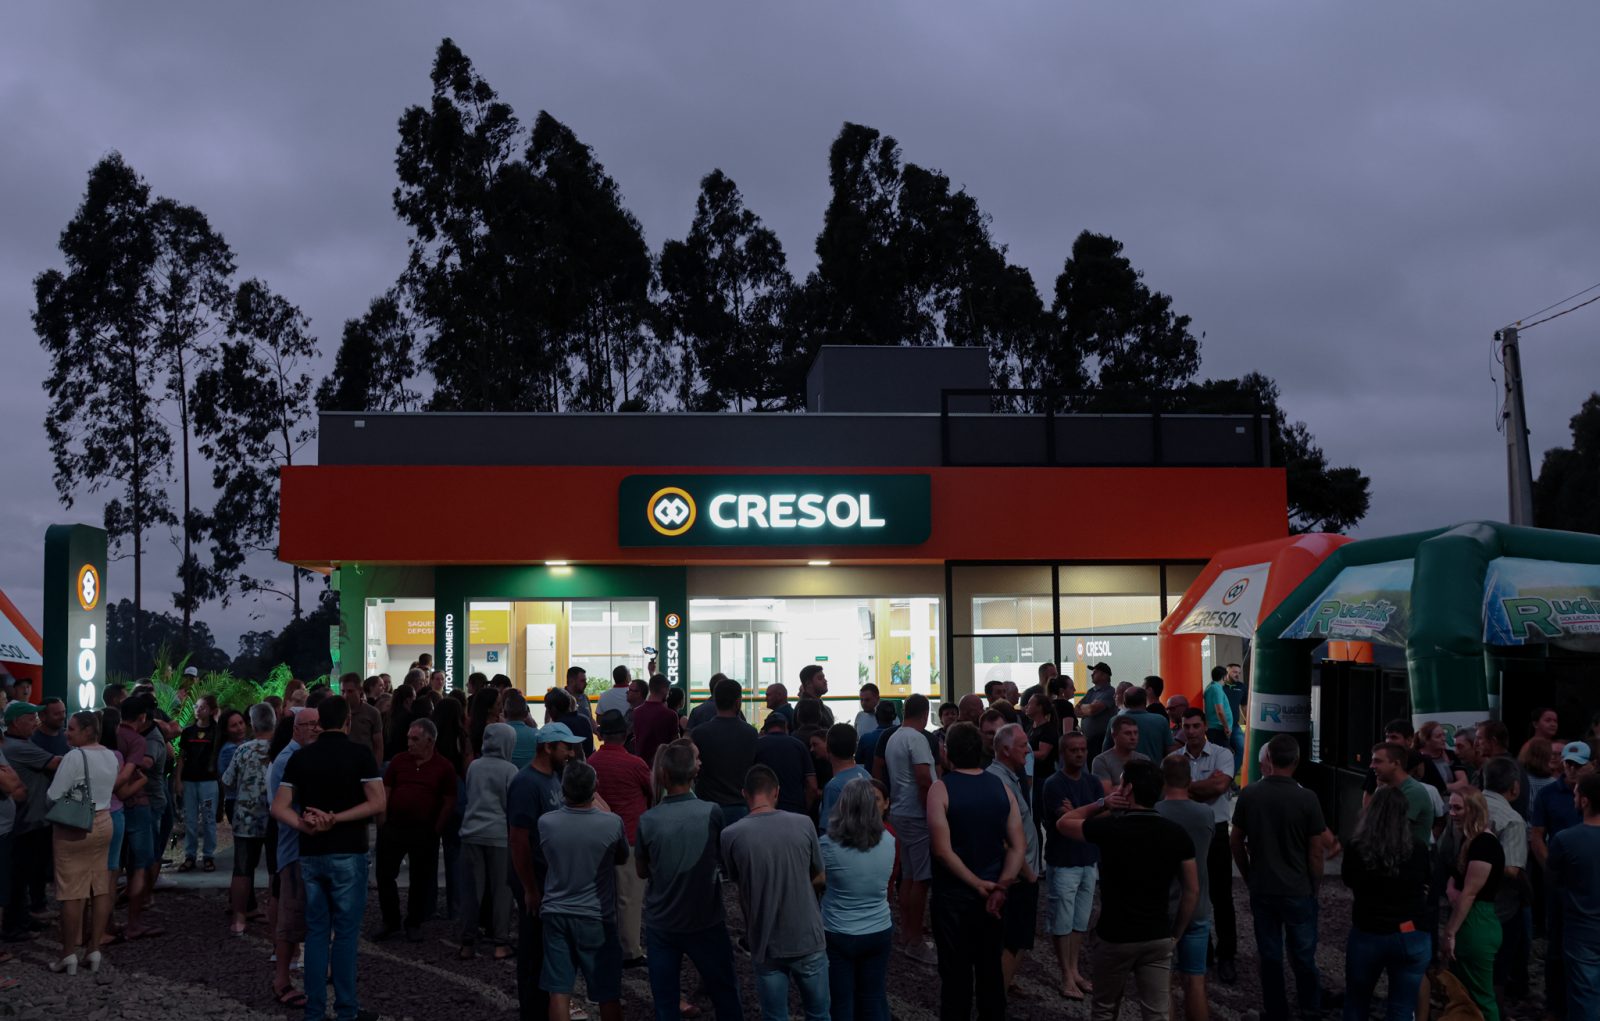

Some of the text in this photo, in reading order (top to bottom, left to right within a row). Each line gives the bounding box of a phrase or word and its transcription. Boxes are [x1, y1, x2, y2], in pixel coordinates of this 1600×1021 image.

[709, 493, 886, 529] CRESOL
[1306, 600, 1396, 634] Rudnik
[78, 623, 96, 710] SOL
[445, 613, 454, 694] UTOATENDIMENTO
[667, 631, 679, 685] CRESOL
[1086, 641, 1112, 657] CRESOL
